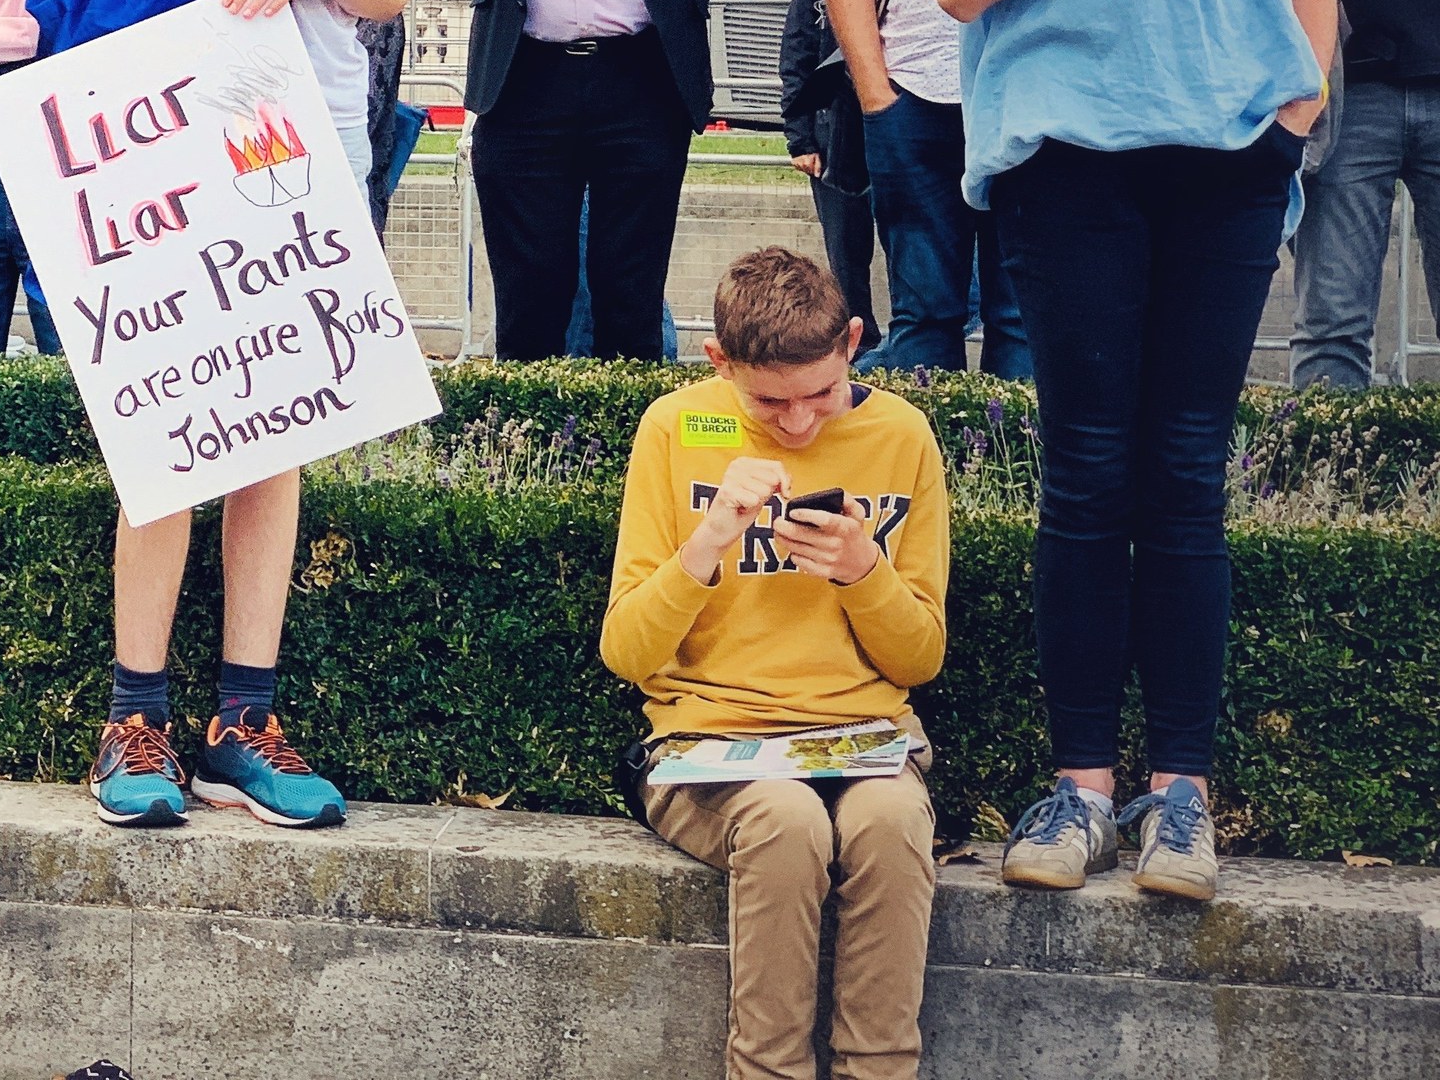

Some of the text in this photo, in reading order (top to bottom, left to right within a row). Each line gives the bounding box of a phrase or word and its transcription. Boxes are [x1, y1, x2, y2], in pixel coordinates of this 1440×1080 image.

[40, 76, 197, 178] Liar
[77, 182, 201, 266] Liar
[73, 211, 351, 364] Your Pants
[114, 365, 186, 417] are
[168, 384, 357, 473] Johnson
[686, 414, 737, 425] BOLLOCKS
[686, 423, 738, 433] TO BREXIT
